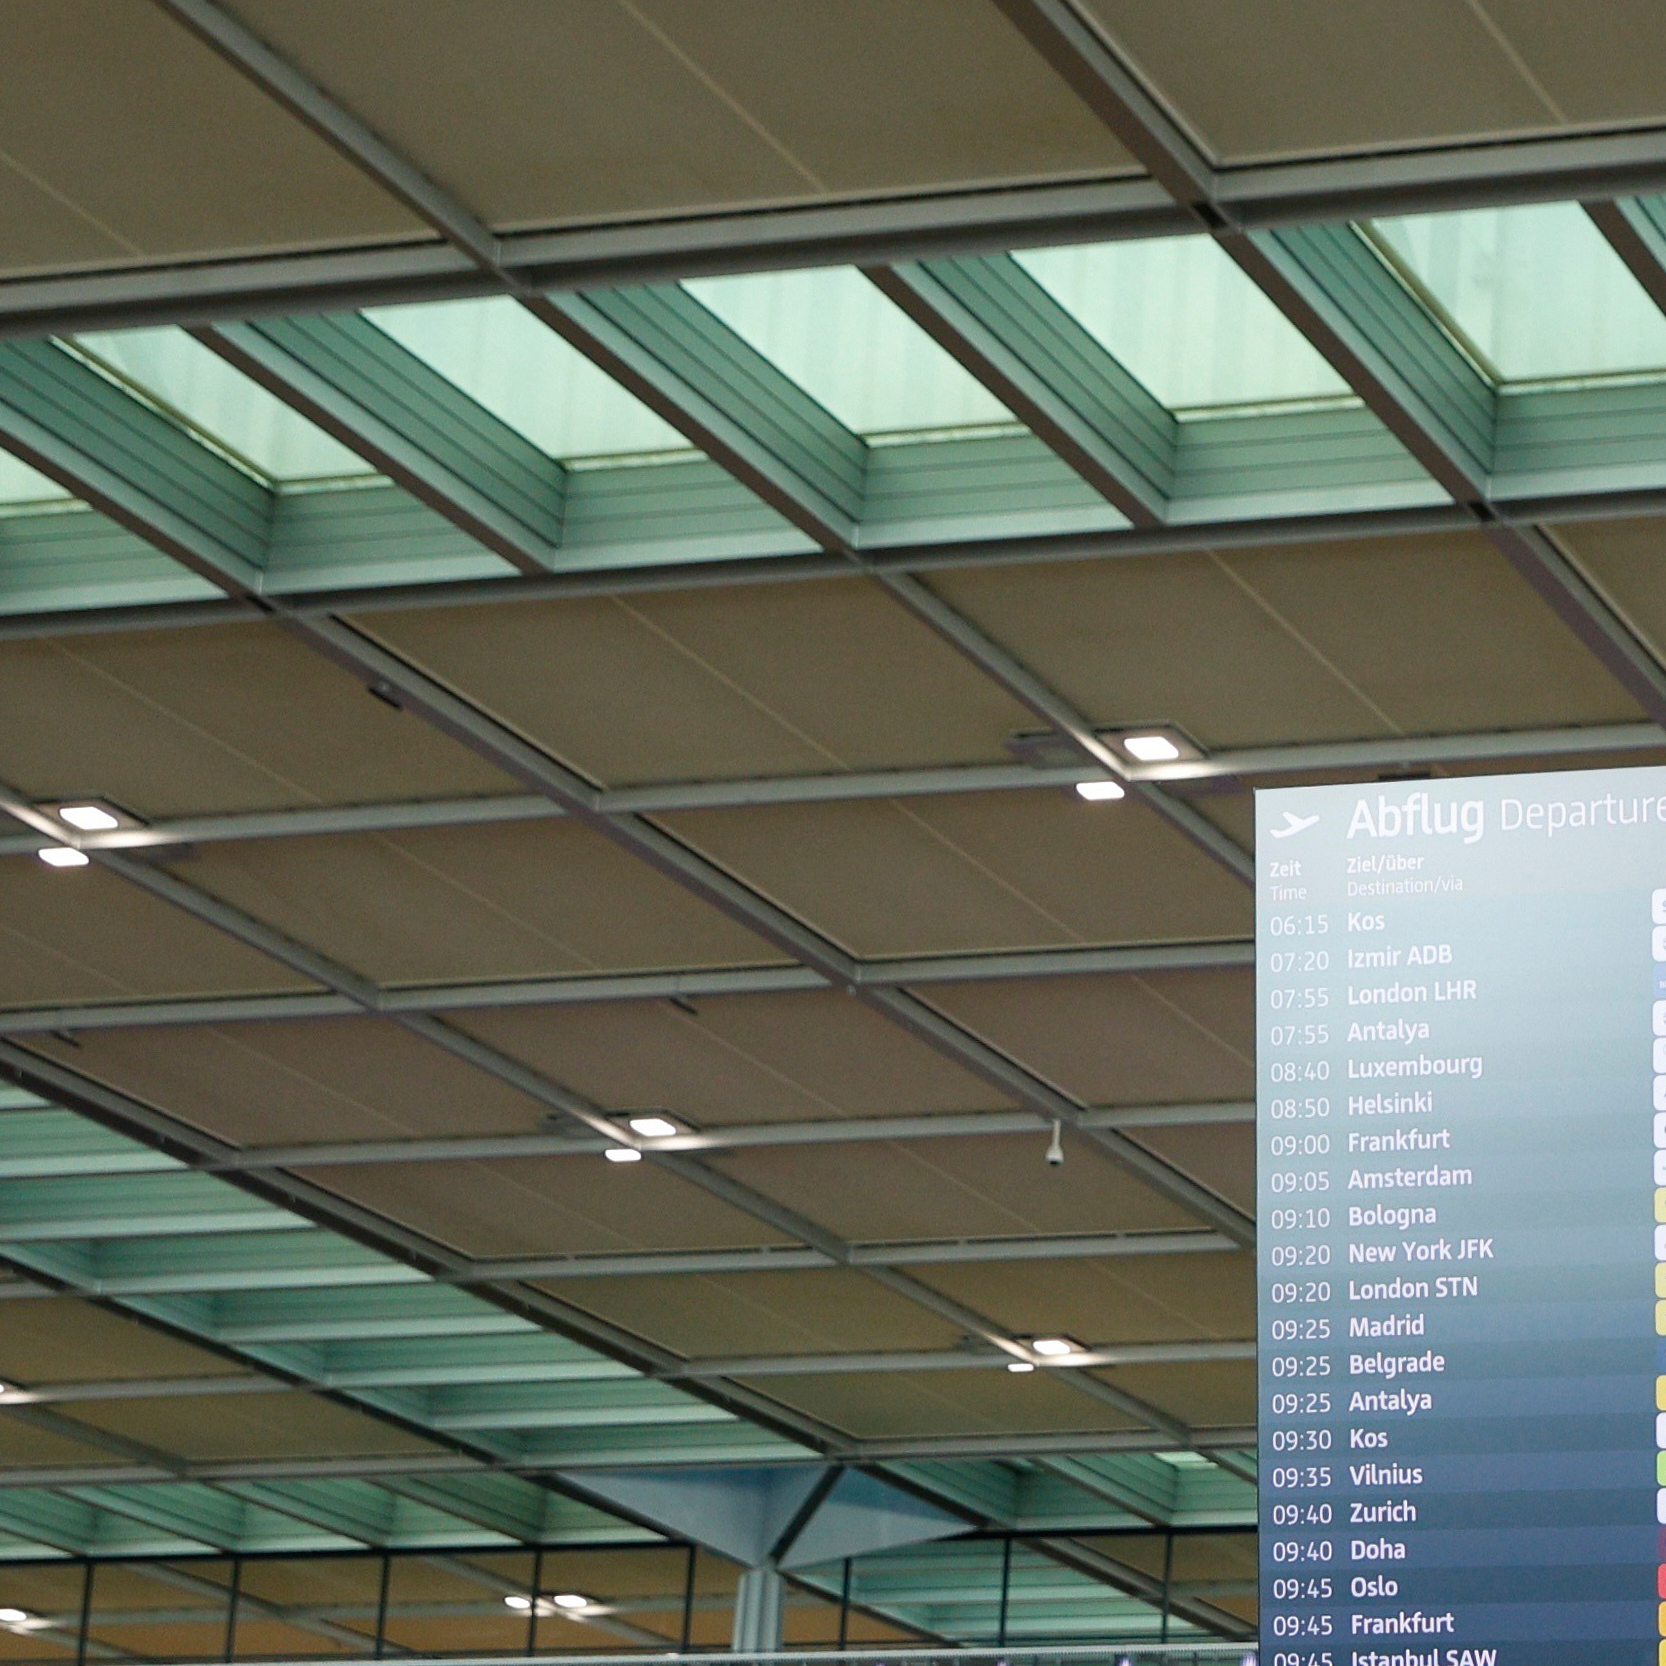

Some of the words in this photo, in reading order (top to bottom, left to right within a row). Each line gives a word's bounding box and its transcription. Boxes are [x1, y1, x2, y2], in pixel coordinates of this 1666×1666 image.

[1347, 792, 1483, 844] Abflug
[1271, 914, 1328, 935] 06:15
[1348, 912, 1384, 931] Kos
[1272, 1245, 1330, 1266] 09:20
[1350, 1244, 1396, 1263] New
[1402, 1239, 1452, 1260] York
[1458, 1239, 1493, 1259] JFK
